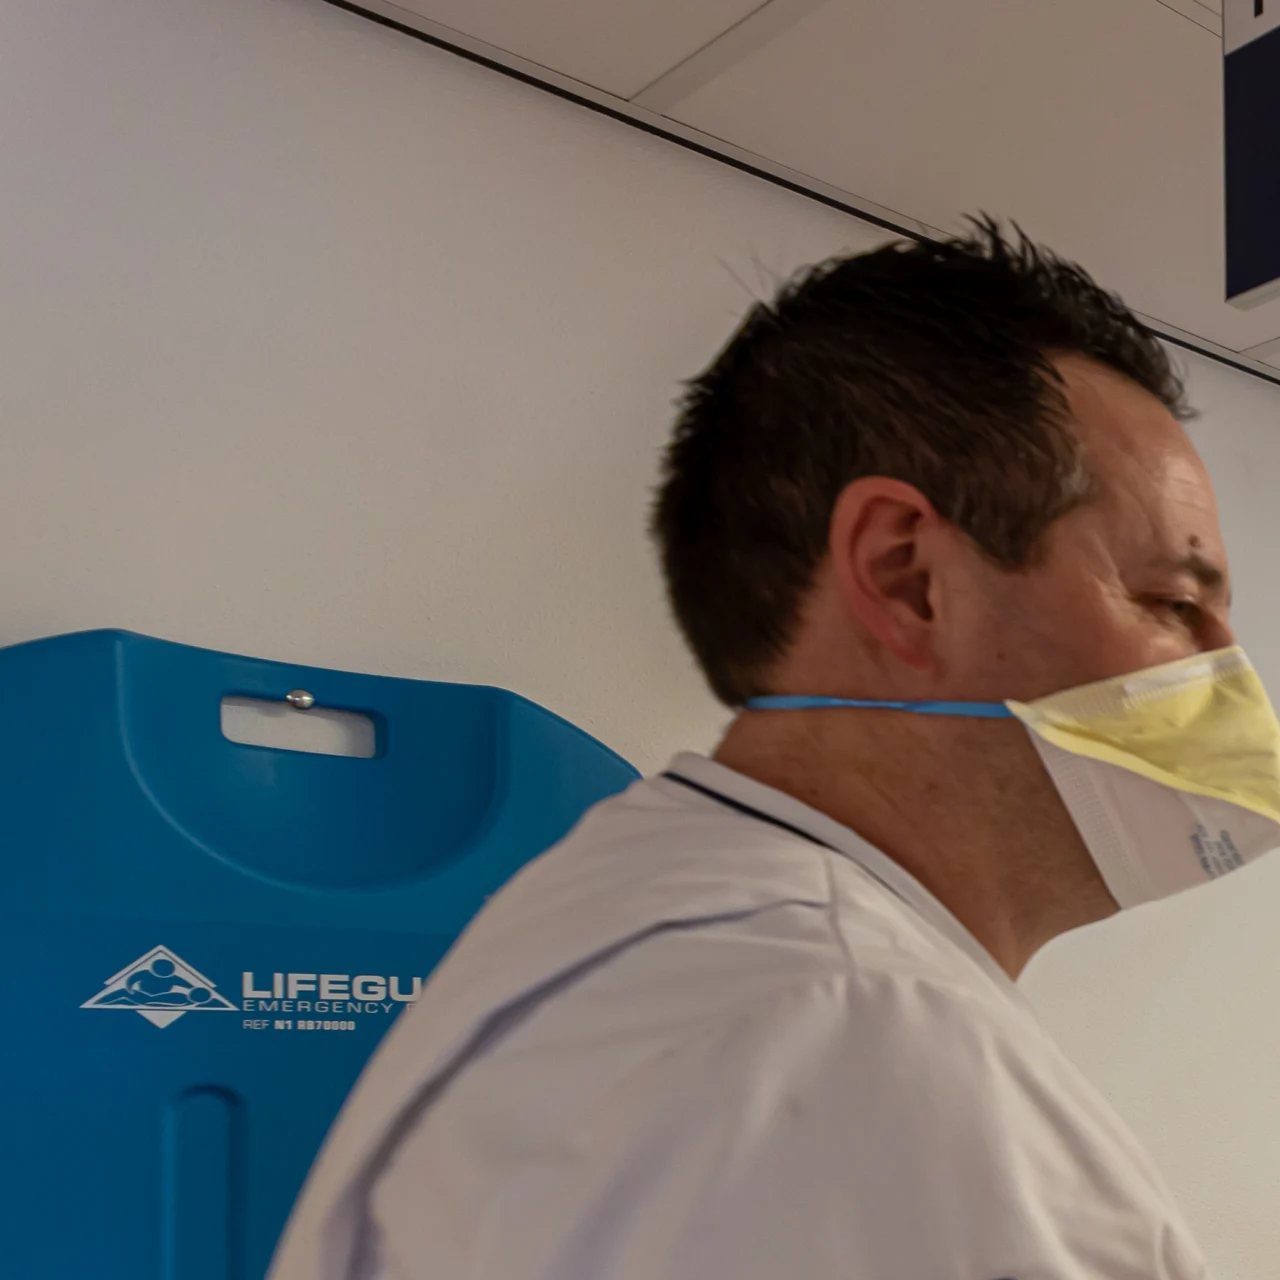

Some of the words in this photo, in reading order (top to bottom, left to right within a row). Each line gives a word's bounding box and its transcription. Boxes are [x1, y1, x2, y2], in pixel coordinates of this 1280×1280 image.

[242, 971, 422, 1002] LIFEGU
[243, 1000, 393, 1014] EMERGENCY
[243, 1019, 270, 1030] REF
[274, 1020, 292, 1030] N1
